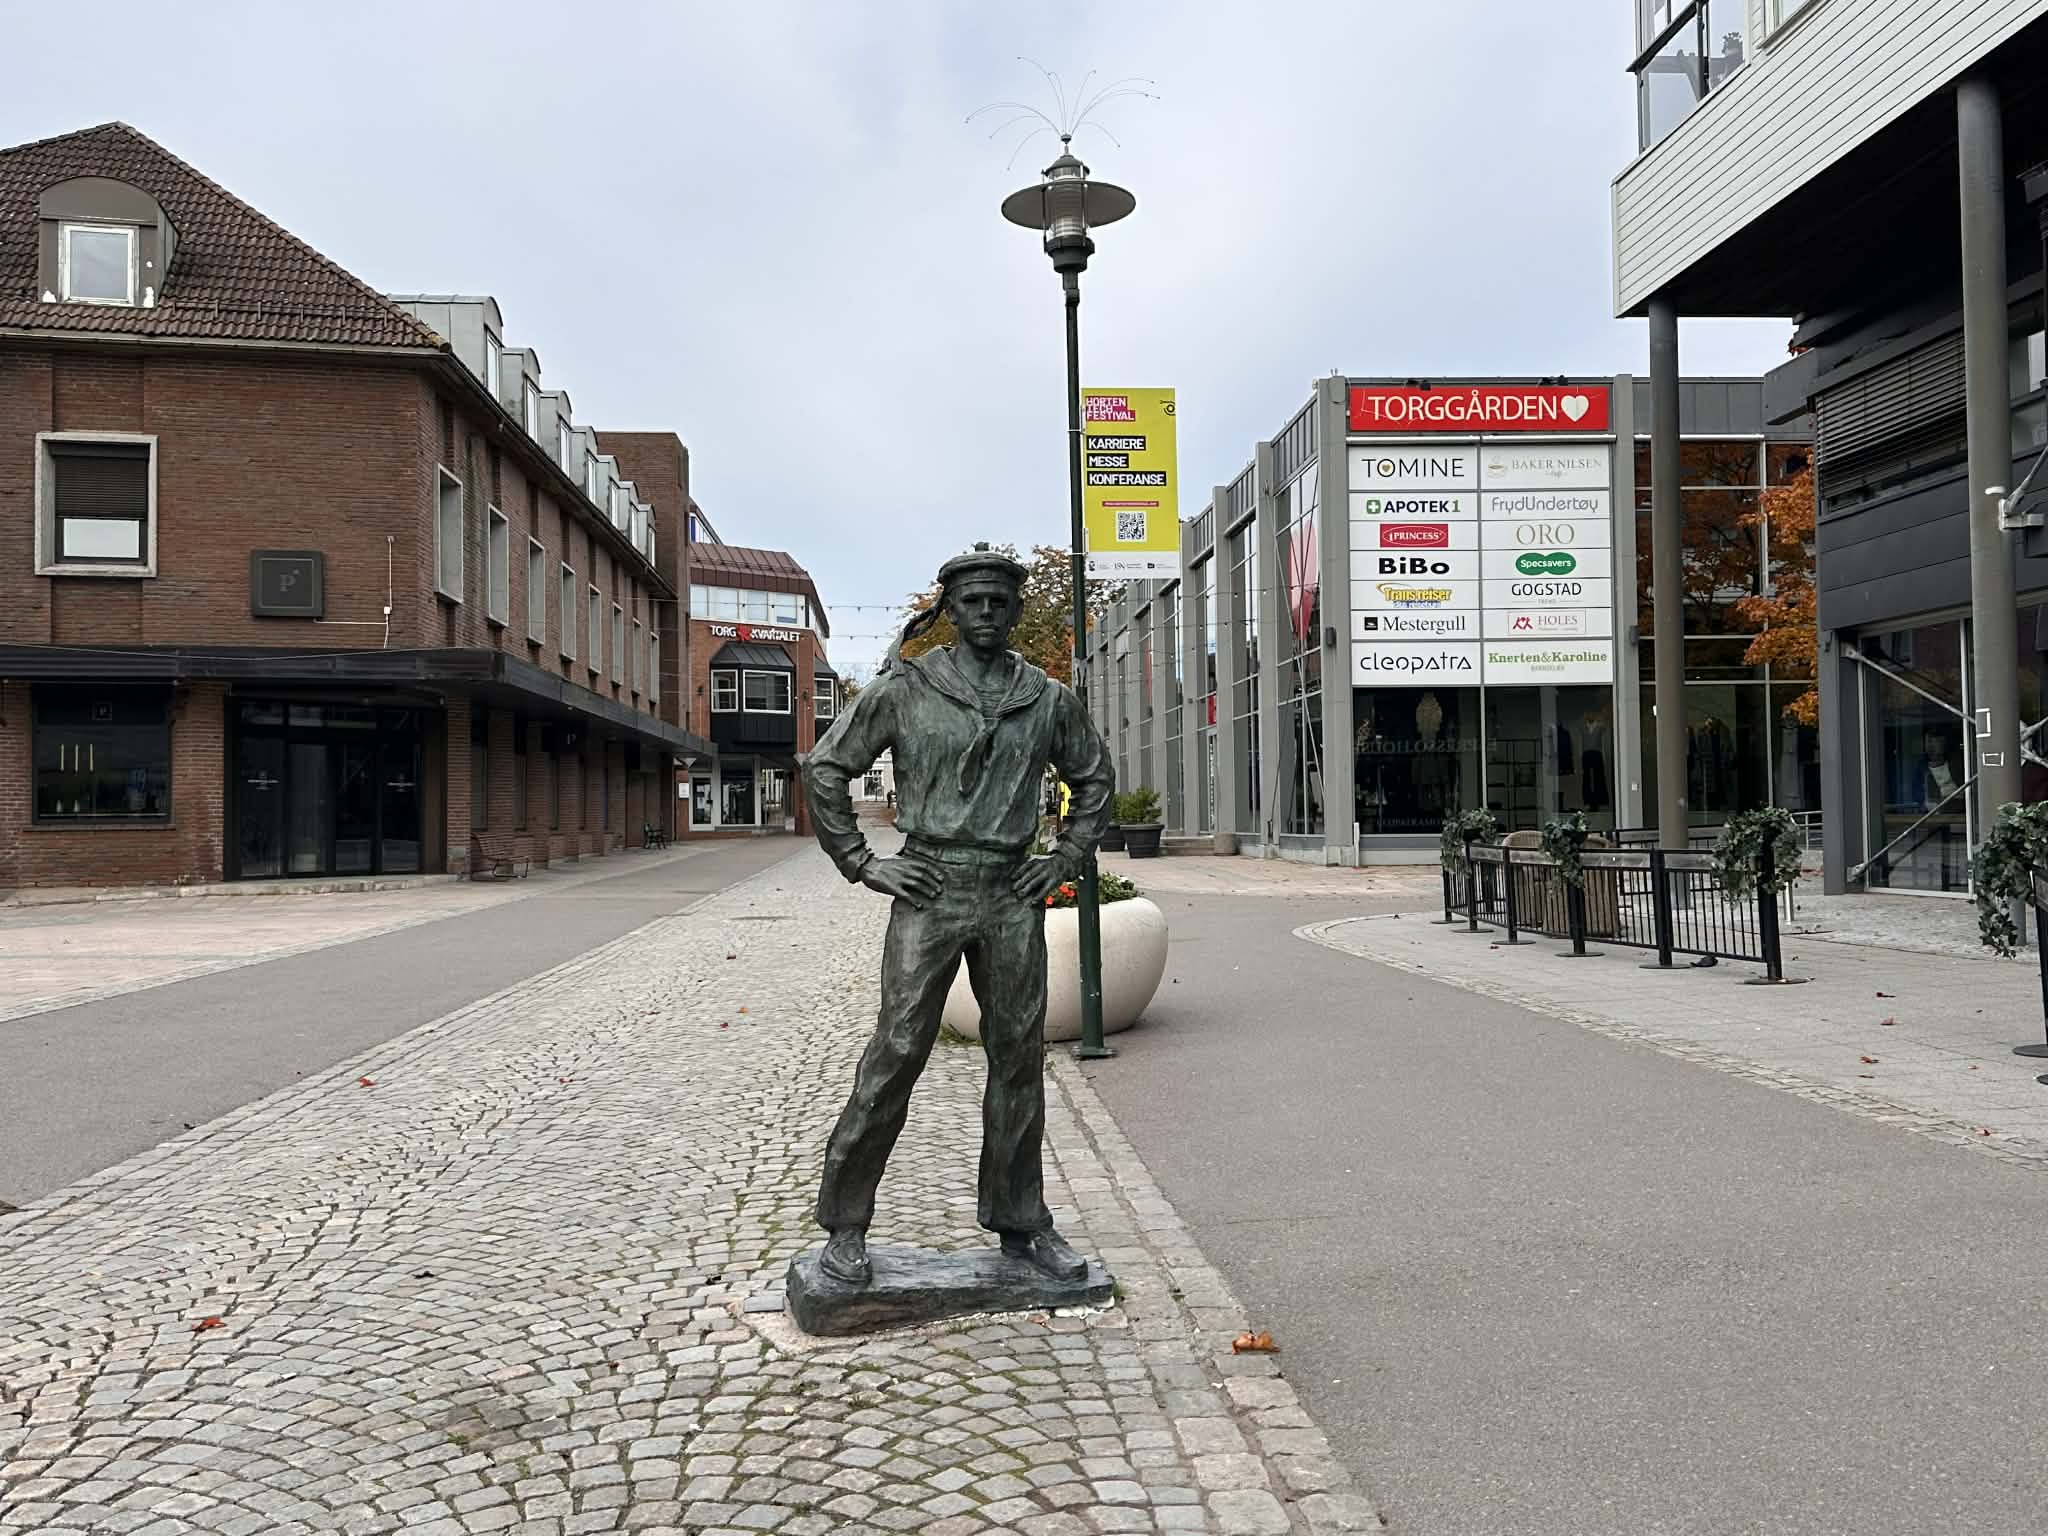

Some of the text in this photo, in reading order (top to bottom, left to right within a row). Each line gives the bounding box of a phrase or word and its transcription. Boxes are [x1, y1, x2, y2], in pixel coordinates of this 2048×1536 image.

[1086, 397, 1127, 406] HORTEN
[1367, 389, 1558, 422] TORGGÅRDEN
[1086, 405, 1113, 413] TECH
[1086, 411, 1135, 421] FESTIVAL
[1088, 438, 1145, 450] KARRIERE
[1088, 455, 1128, 468] MESSE
[1361, 457, 1465, 478] TOMINE
[1511, 457, 1603, 471] BAKER NILSEN
[1088, 473, 1165, 486] KONFERANSE
[1383, 499, 1462, 514] APOTEK 1
[1491, 495, 1600, 516] FrydUndertøy
[1393, 531, 1440, 541] PRINCESS
[1515, 523, 1576, 546] ORO
[1378, 556, 1451, 576] BiBo
[1519, 557, 1573, 569] Specsavers
[1511, 582, 1583, 597] GOGSTAD
[1383, 615, 1467, 635] Mestergull
[1537, 615, 1579, 627] HOLES
[711, 625, 800, 643] TORG KVARTALET
[1359, 651, 1473, 675] cleopatra
[1487, 651, 1608, 664] Knerten&Karoline
